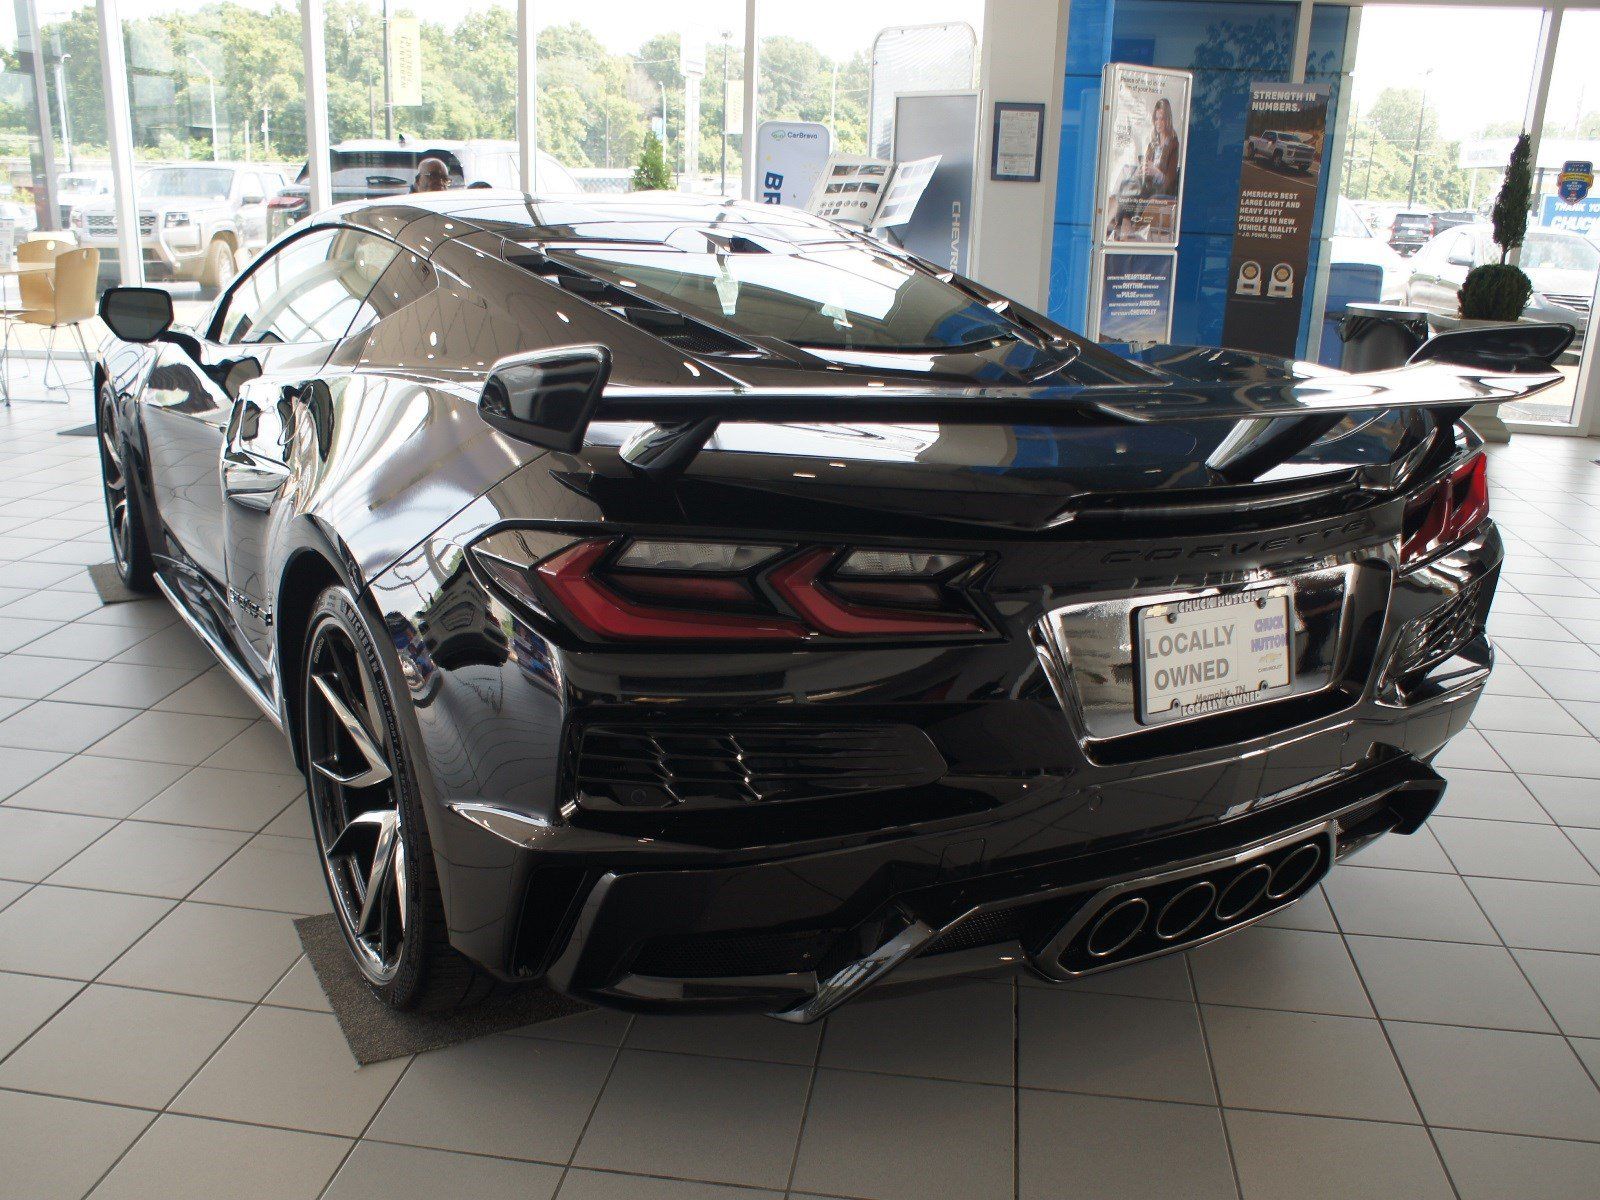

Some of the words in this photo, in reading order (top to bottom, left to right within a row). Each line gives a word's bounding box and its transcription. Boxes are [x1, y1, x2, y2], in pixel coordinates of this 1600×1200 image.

[1253, 91, 1303, 101] STRENGTH
[1305, 92, 1316, 102] IN
[787, 131, 818, 139] CarBravo
[1241, 190, 1279, 199] AMERICA'S
[1280, 192, 1298, 200] BEST
[1239, 207, 1263, 215] HEAVY
[1240, 199, 1263, 207] LARGE
[1264, 200, 1284, 208] LIGHT
[1285, 201, 1301, 209] AND
[1554, 201, 1587, 212] THANK
[1238, 215, 1269, 224] PICKUPS
[1238, 224, 1267, 232] VEHICLE
[1267, 226, 1298, 234] QUALITY
[1100, 517, 1373, 564] CORVETTE
[1177, 598, 1214, 613] CHUCK
[1216, 590, 1259, 609] HUTTON
[1253, 615, 1284, 633] CHUCK
[340, 599, 379, 674] MICHELIN
[1144, 624, 1235, 659] LOCALLY
[1250, 633, 1288, 653] HUTTON
[1154, 657, 1230, 691] OWNED
[1181, 698, 1223, 717] LOCALLY
